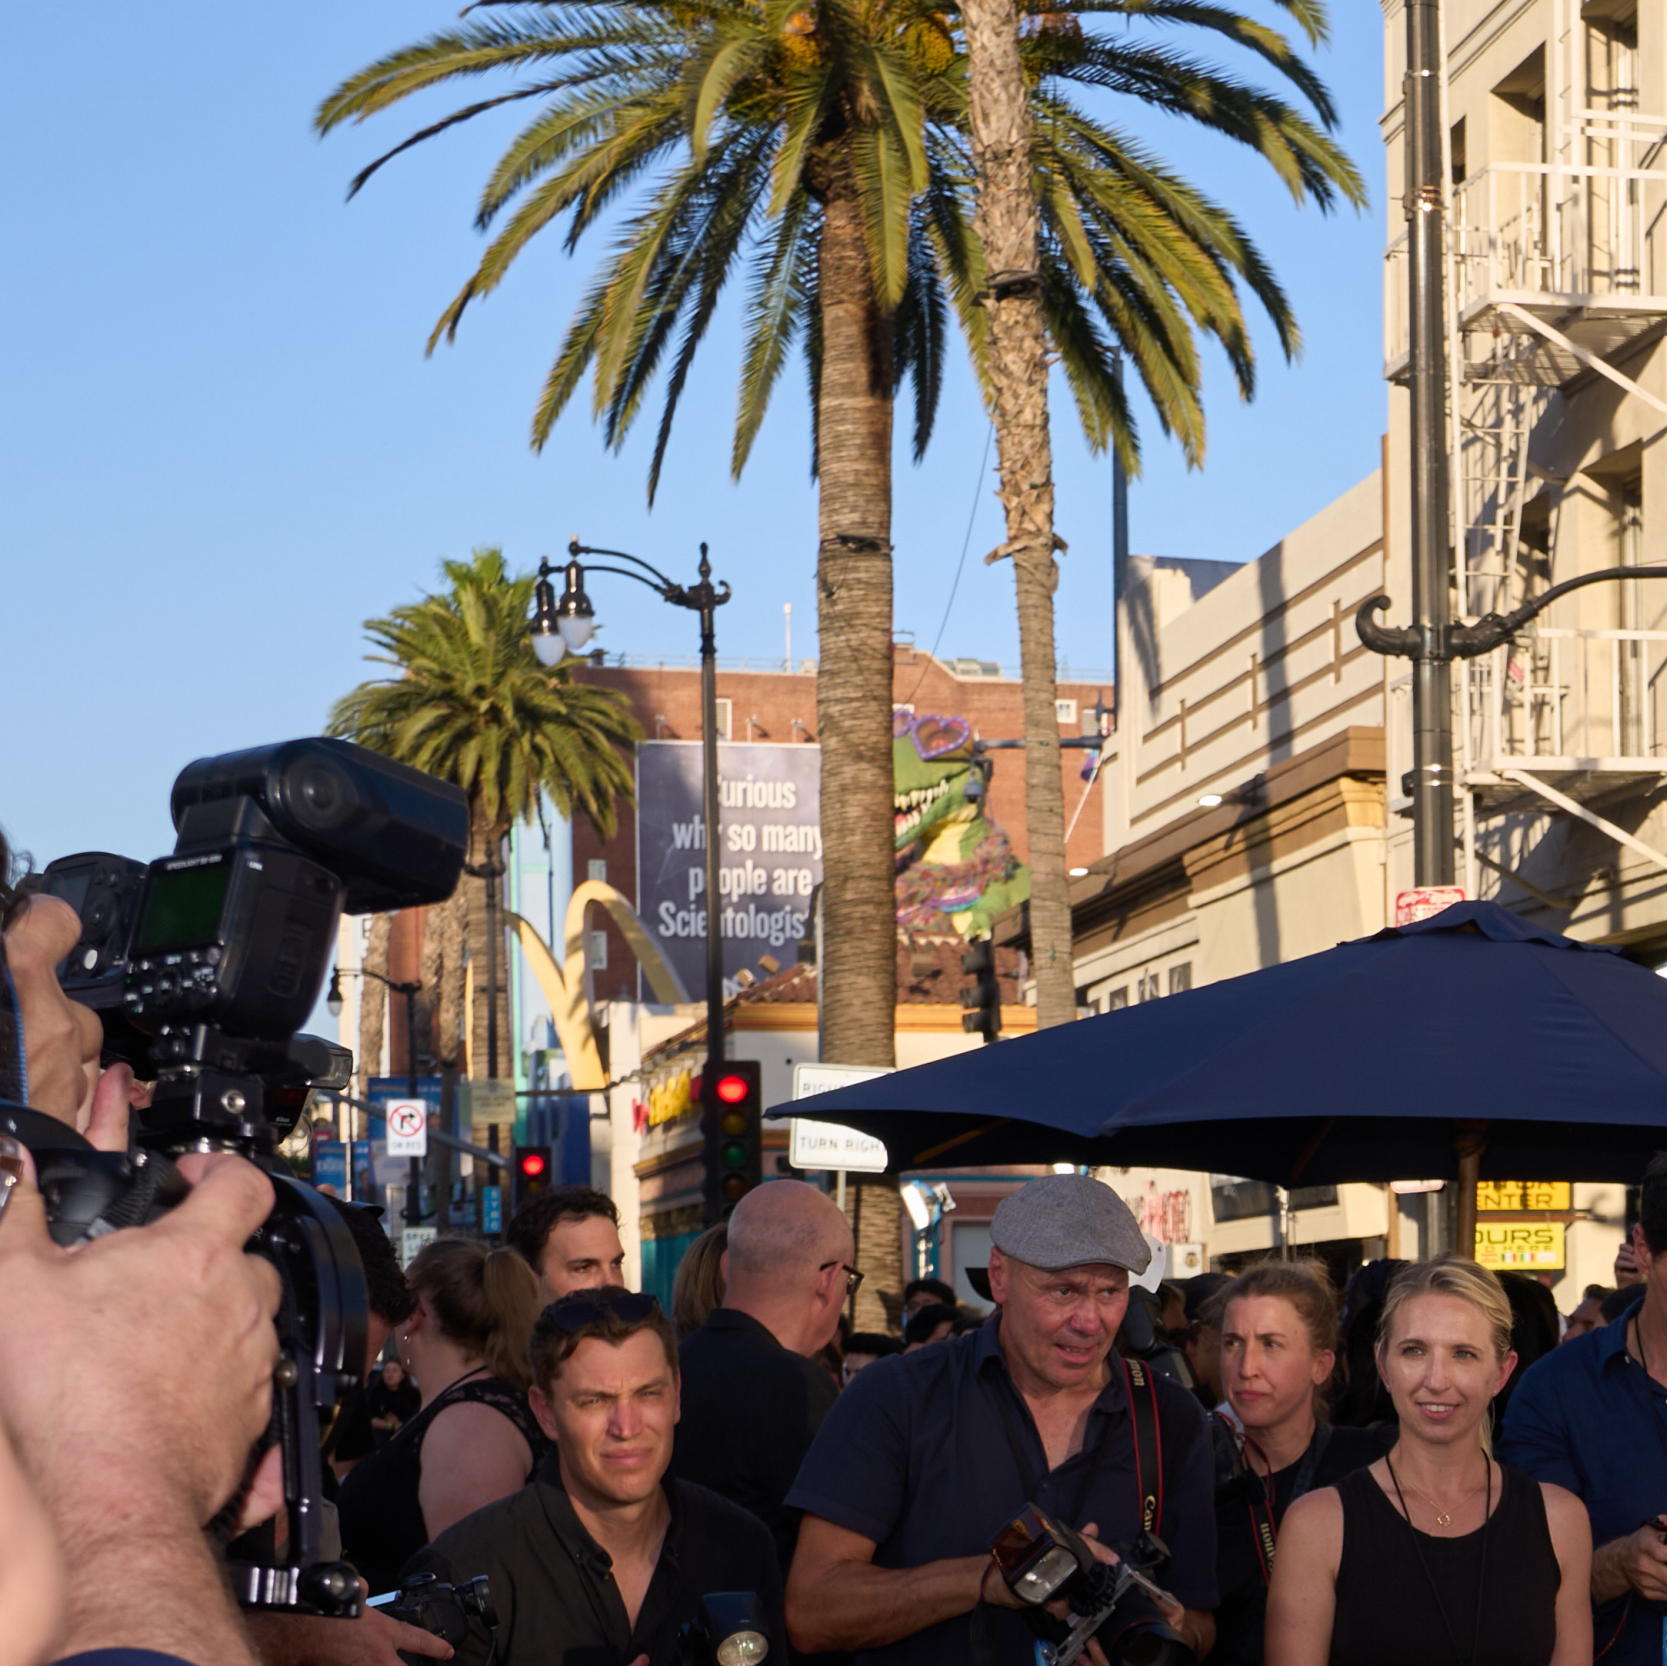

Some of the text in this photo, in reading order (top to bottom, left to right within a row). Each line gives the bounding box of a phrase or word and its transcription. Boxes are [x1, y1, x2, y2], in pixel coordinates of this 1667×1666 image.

[728, 824, 756, 851] so
[762, 823, 822, 860] many
[689, 860, 813, 902] pople are
[658, 900, 809, 946] Scietologis
[800, 1136, 885, 1152] TURN RIGH
